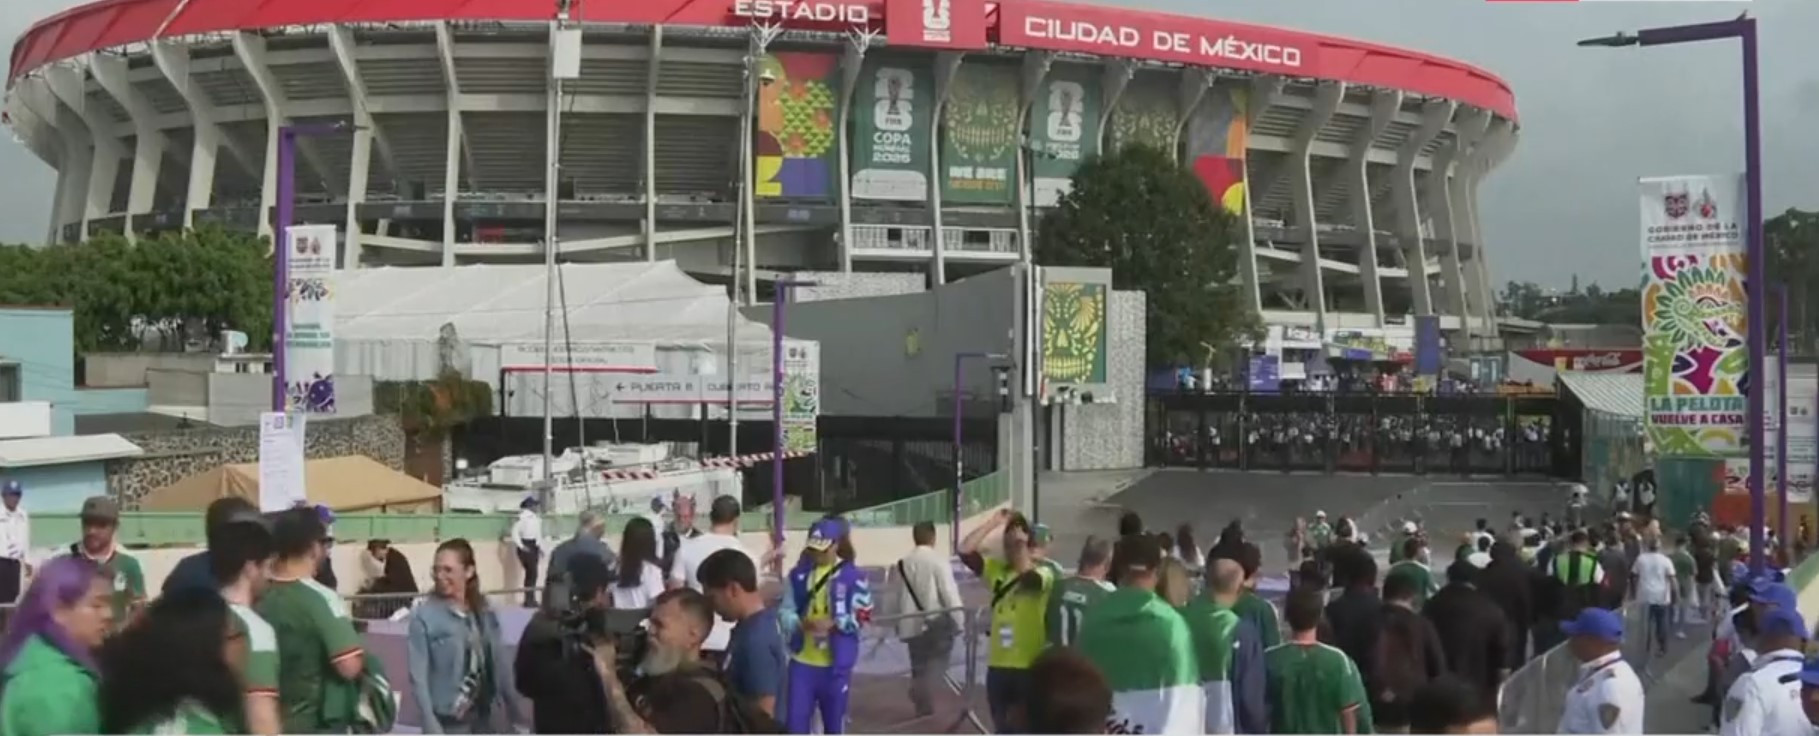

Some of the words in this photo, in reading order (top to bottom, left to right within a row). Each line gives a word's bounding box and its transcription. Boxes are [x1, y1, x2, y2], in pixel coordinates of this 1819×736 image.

[734, 0, 868, 23] ESTADIO
[1024, 15, 1140, 47] CIUDAD
[1153, 30, 1191, 53] DE
[1200, 35, 1301, 67] MÉXICO
[873, 132, 912, 147] COPA
[1651, 397, 1672, 411] LA
[1677, 396, 1744, 411] PELOTA
[1651, 414, 1697, 425] VUELVE
[1700, 414, 1709, 425] A
[1711, 414, 1744, 425] CASA
